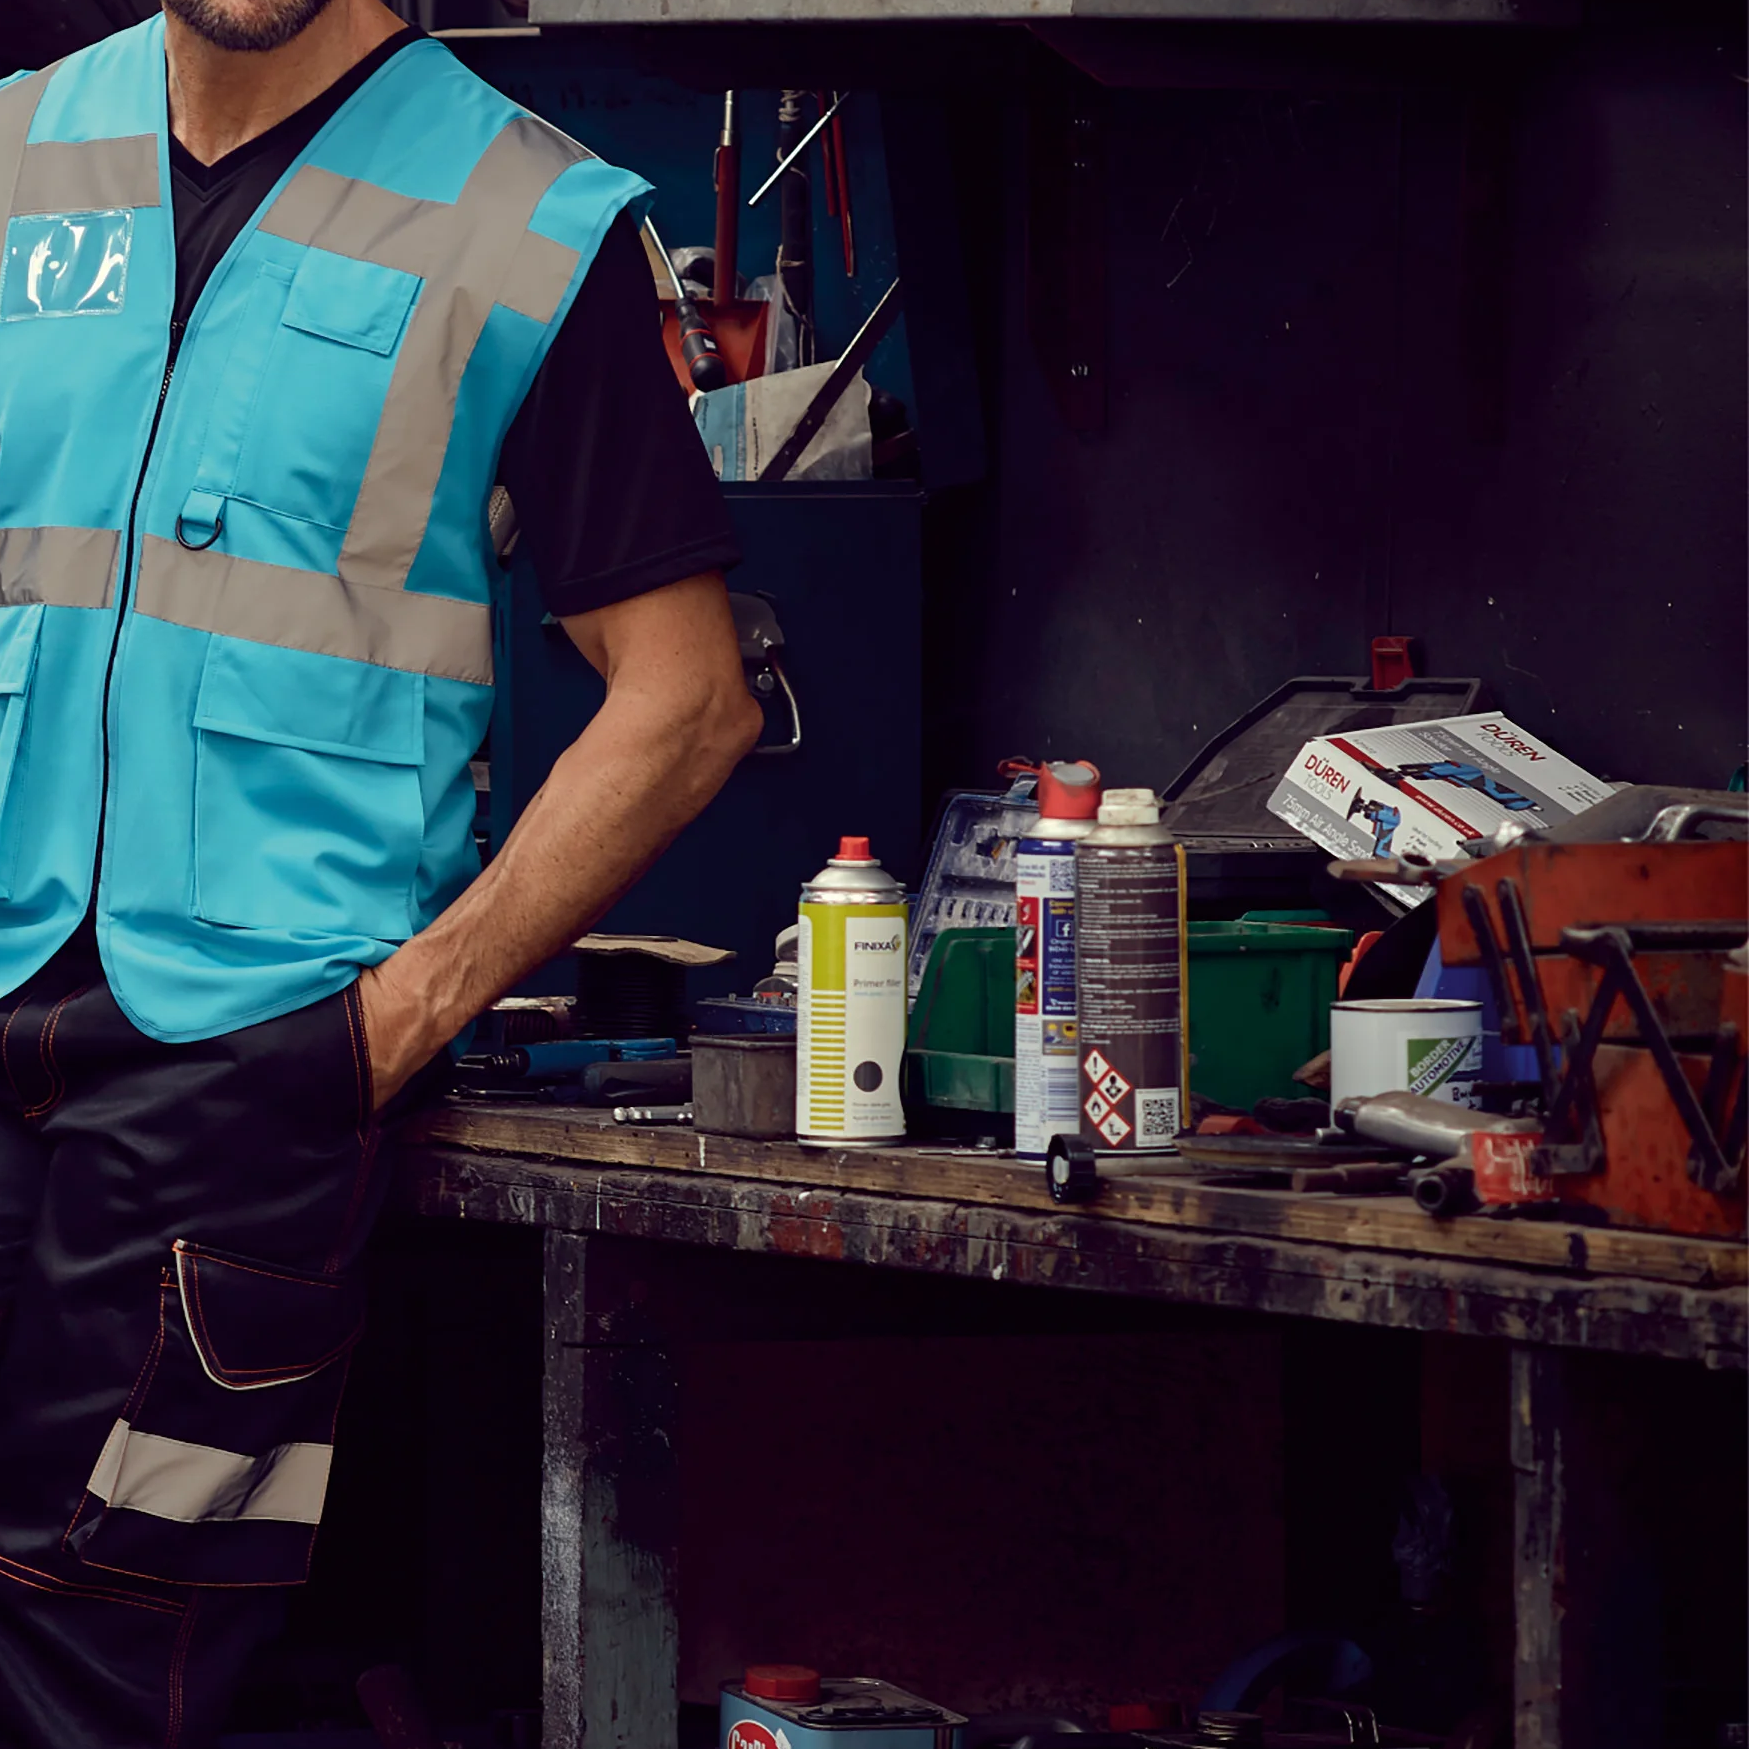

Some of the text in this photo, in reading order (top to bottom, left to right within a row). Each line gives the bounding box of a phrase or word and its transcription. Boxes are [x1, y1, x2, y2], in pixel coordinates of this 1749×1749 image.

[1480, 723, 1547, 762] DÜREN
[1303, 774, 1334, 801] TOOLS
[1304, 754, 1351, 794] DÜREN
[1282, 793, 1311, 821] 75mm
[854, 941, 894, 951] FINIXA
[1410, 1038, 1452, 1078] BORDER
[1410, 1039, 1467, 1095] AUTOMOTIVE
